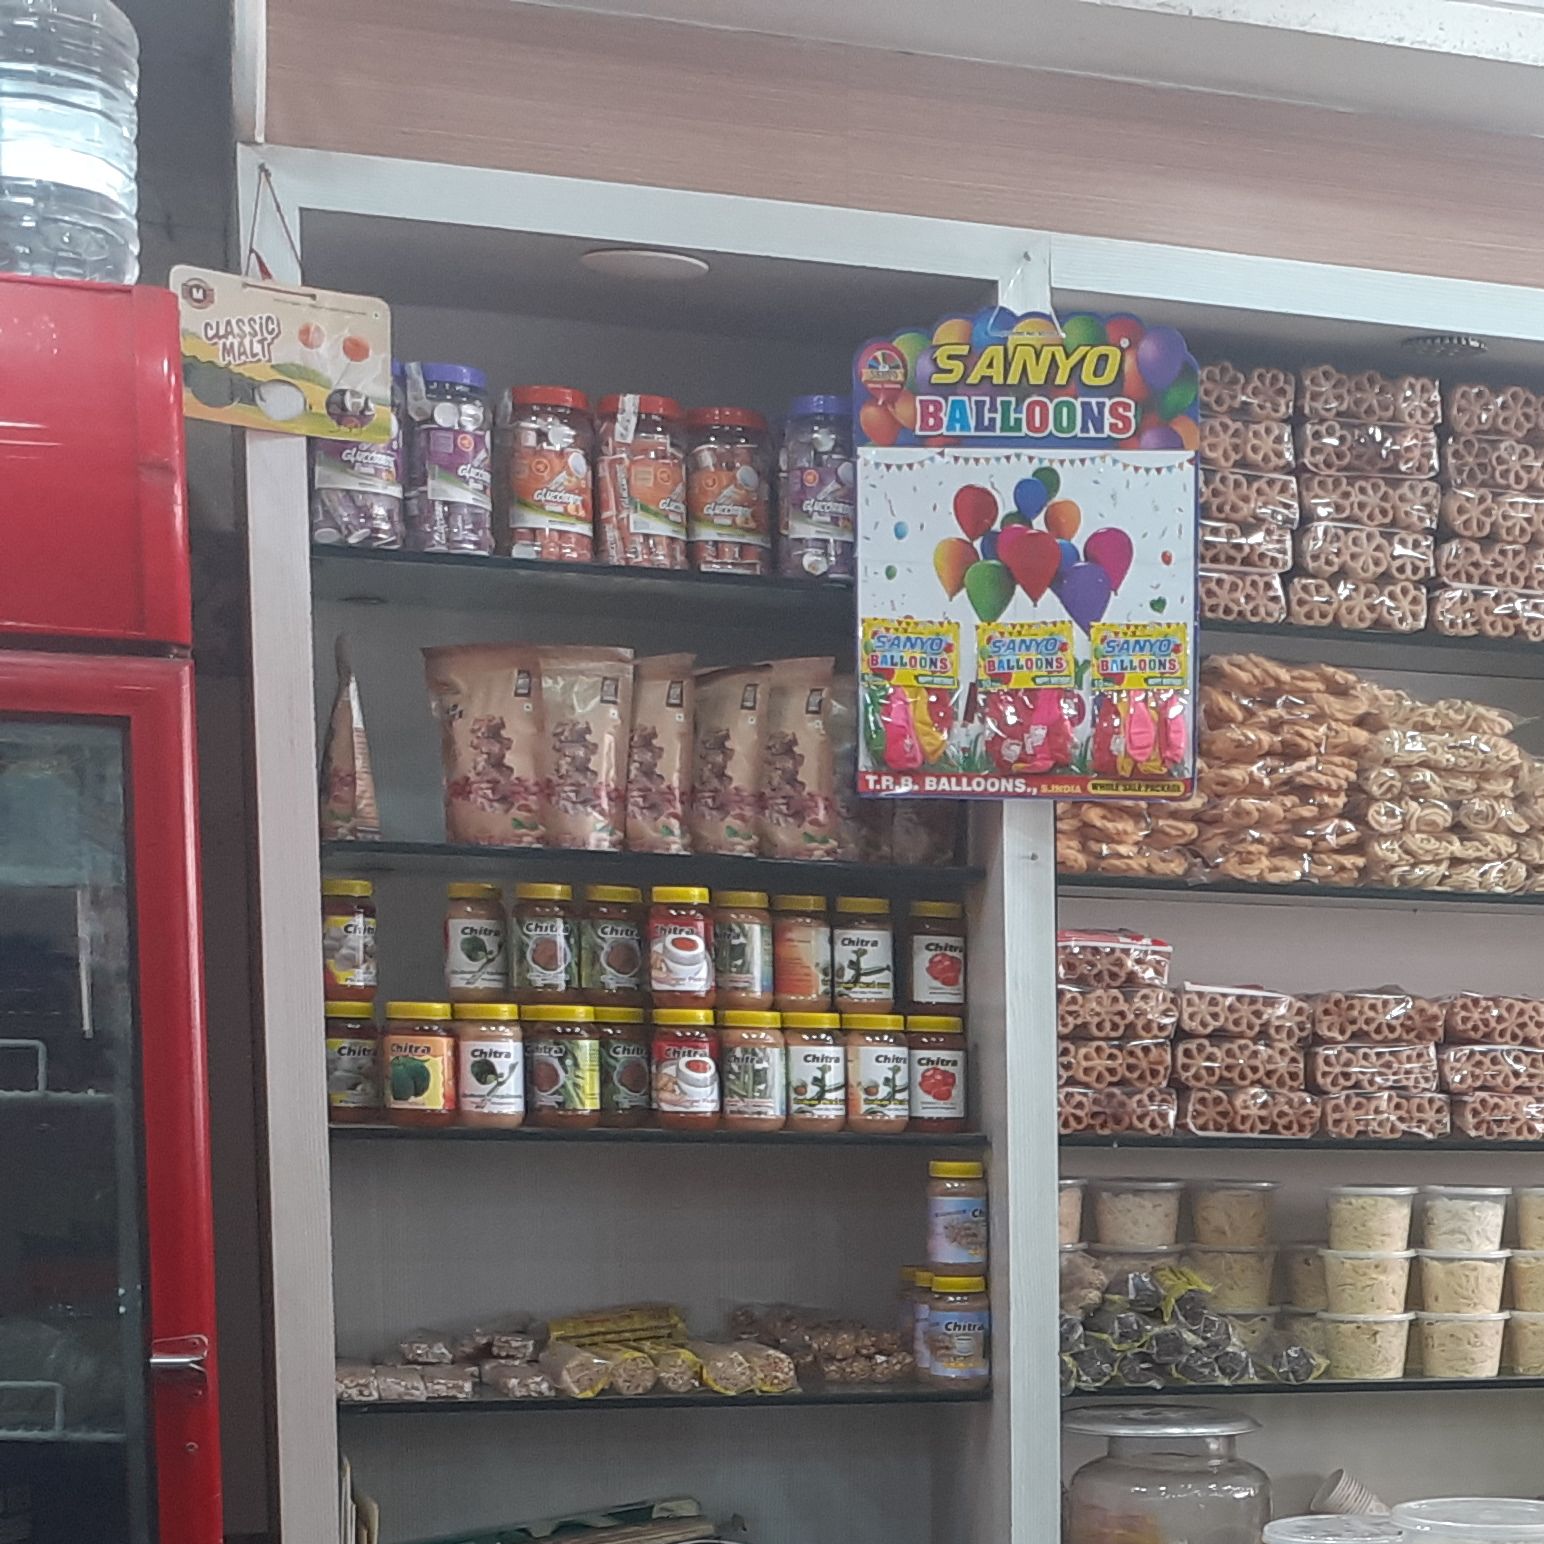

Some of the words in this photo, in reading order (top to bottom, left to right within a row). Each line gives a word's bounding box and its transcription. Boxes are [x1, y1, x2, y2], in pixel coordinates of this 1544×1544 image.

[221, 336, 273, 365] MALT
[930, 342, 1123, 387] SANYO
[915, 395, 1136, 438] BALLOONS
[874, 634, 944, 654] SANYO
[990, 637, 1060, 654] SANYO
[1105, 637, 1173, 654] SANYO
[869, 654, 949, 671] BALLOONS
[986, 656, 1066, 673] BALLOONS
[1101, 656, 1179, 672] BALLOONS
[839, 937, 880, 949] Chitra
[390, 1042, 432, 1055] Chitra
[470, 1047, 512, 1060] Chitra
[665, 1046, 709, 1059] Chitra
[803, 1053, 841, 1064] Chitra
[917, 1056, 959, 1068] Chitra
[944, 1321, 986, 1333] Chitra
